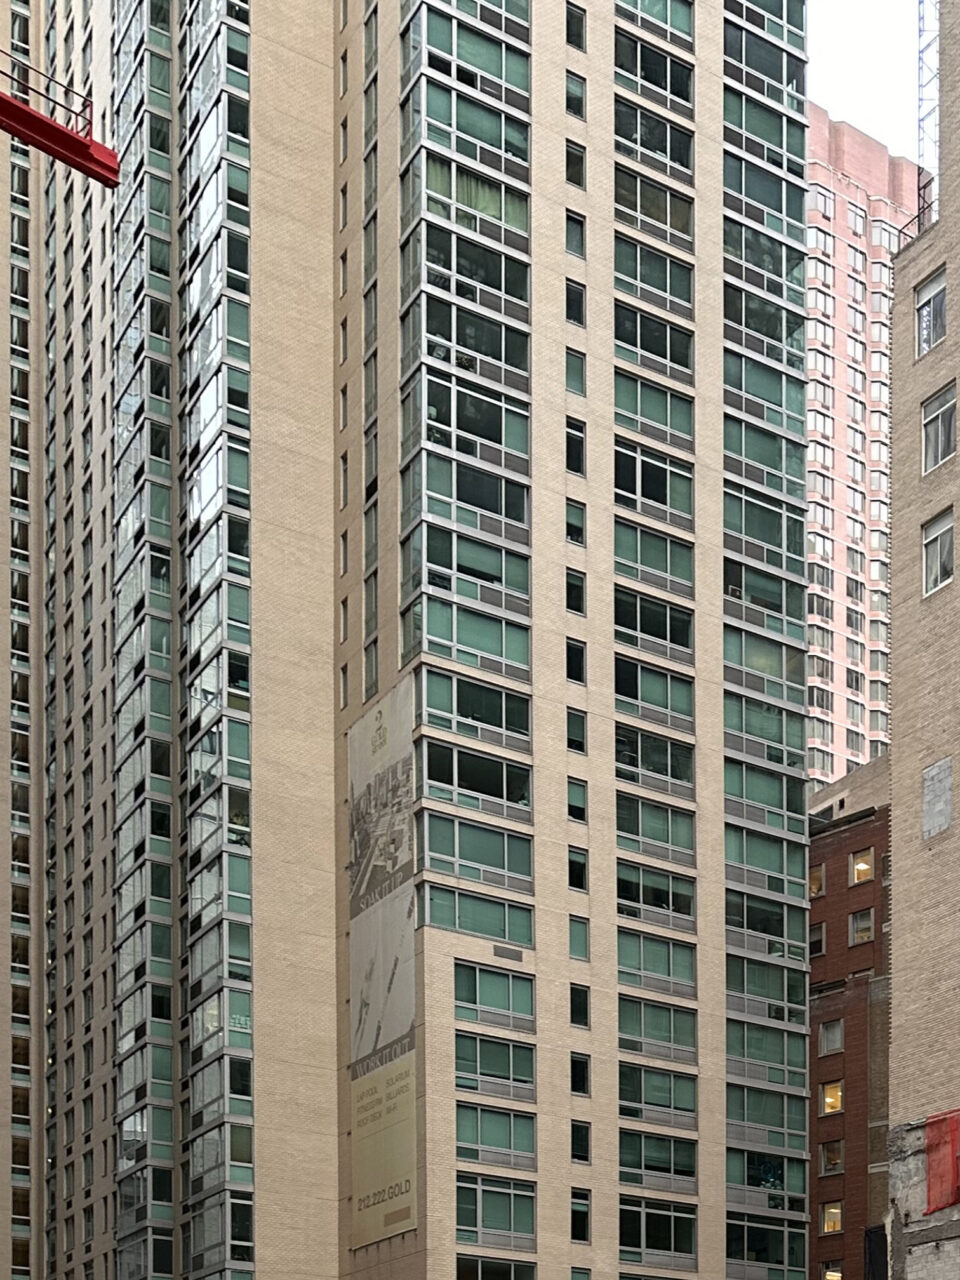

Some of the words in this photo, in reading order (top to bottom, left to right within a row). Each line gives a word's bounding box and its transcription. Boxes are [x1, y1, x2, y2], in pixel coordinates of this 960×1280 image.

[356, 1053, 381, 1077] WORK
[382, 1048, 391, 1065] IT
[392, 1038, 410, 1059] OUT
[358, 1179, 411, 1211] 212.222.GOLD
